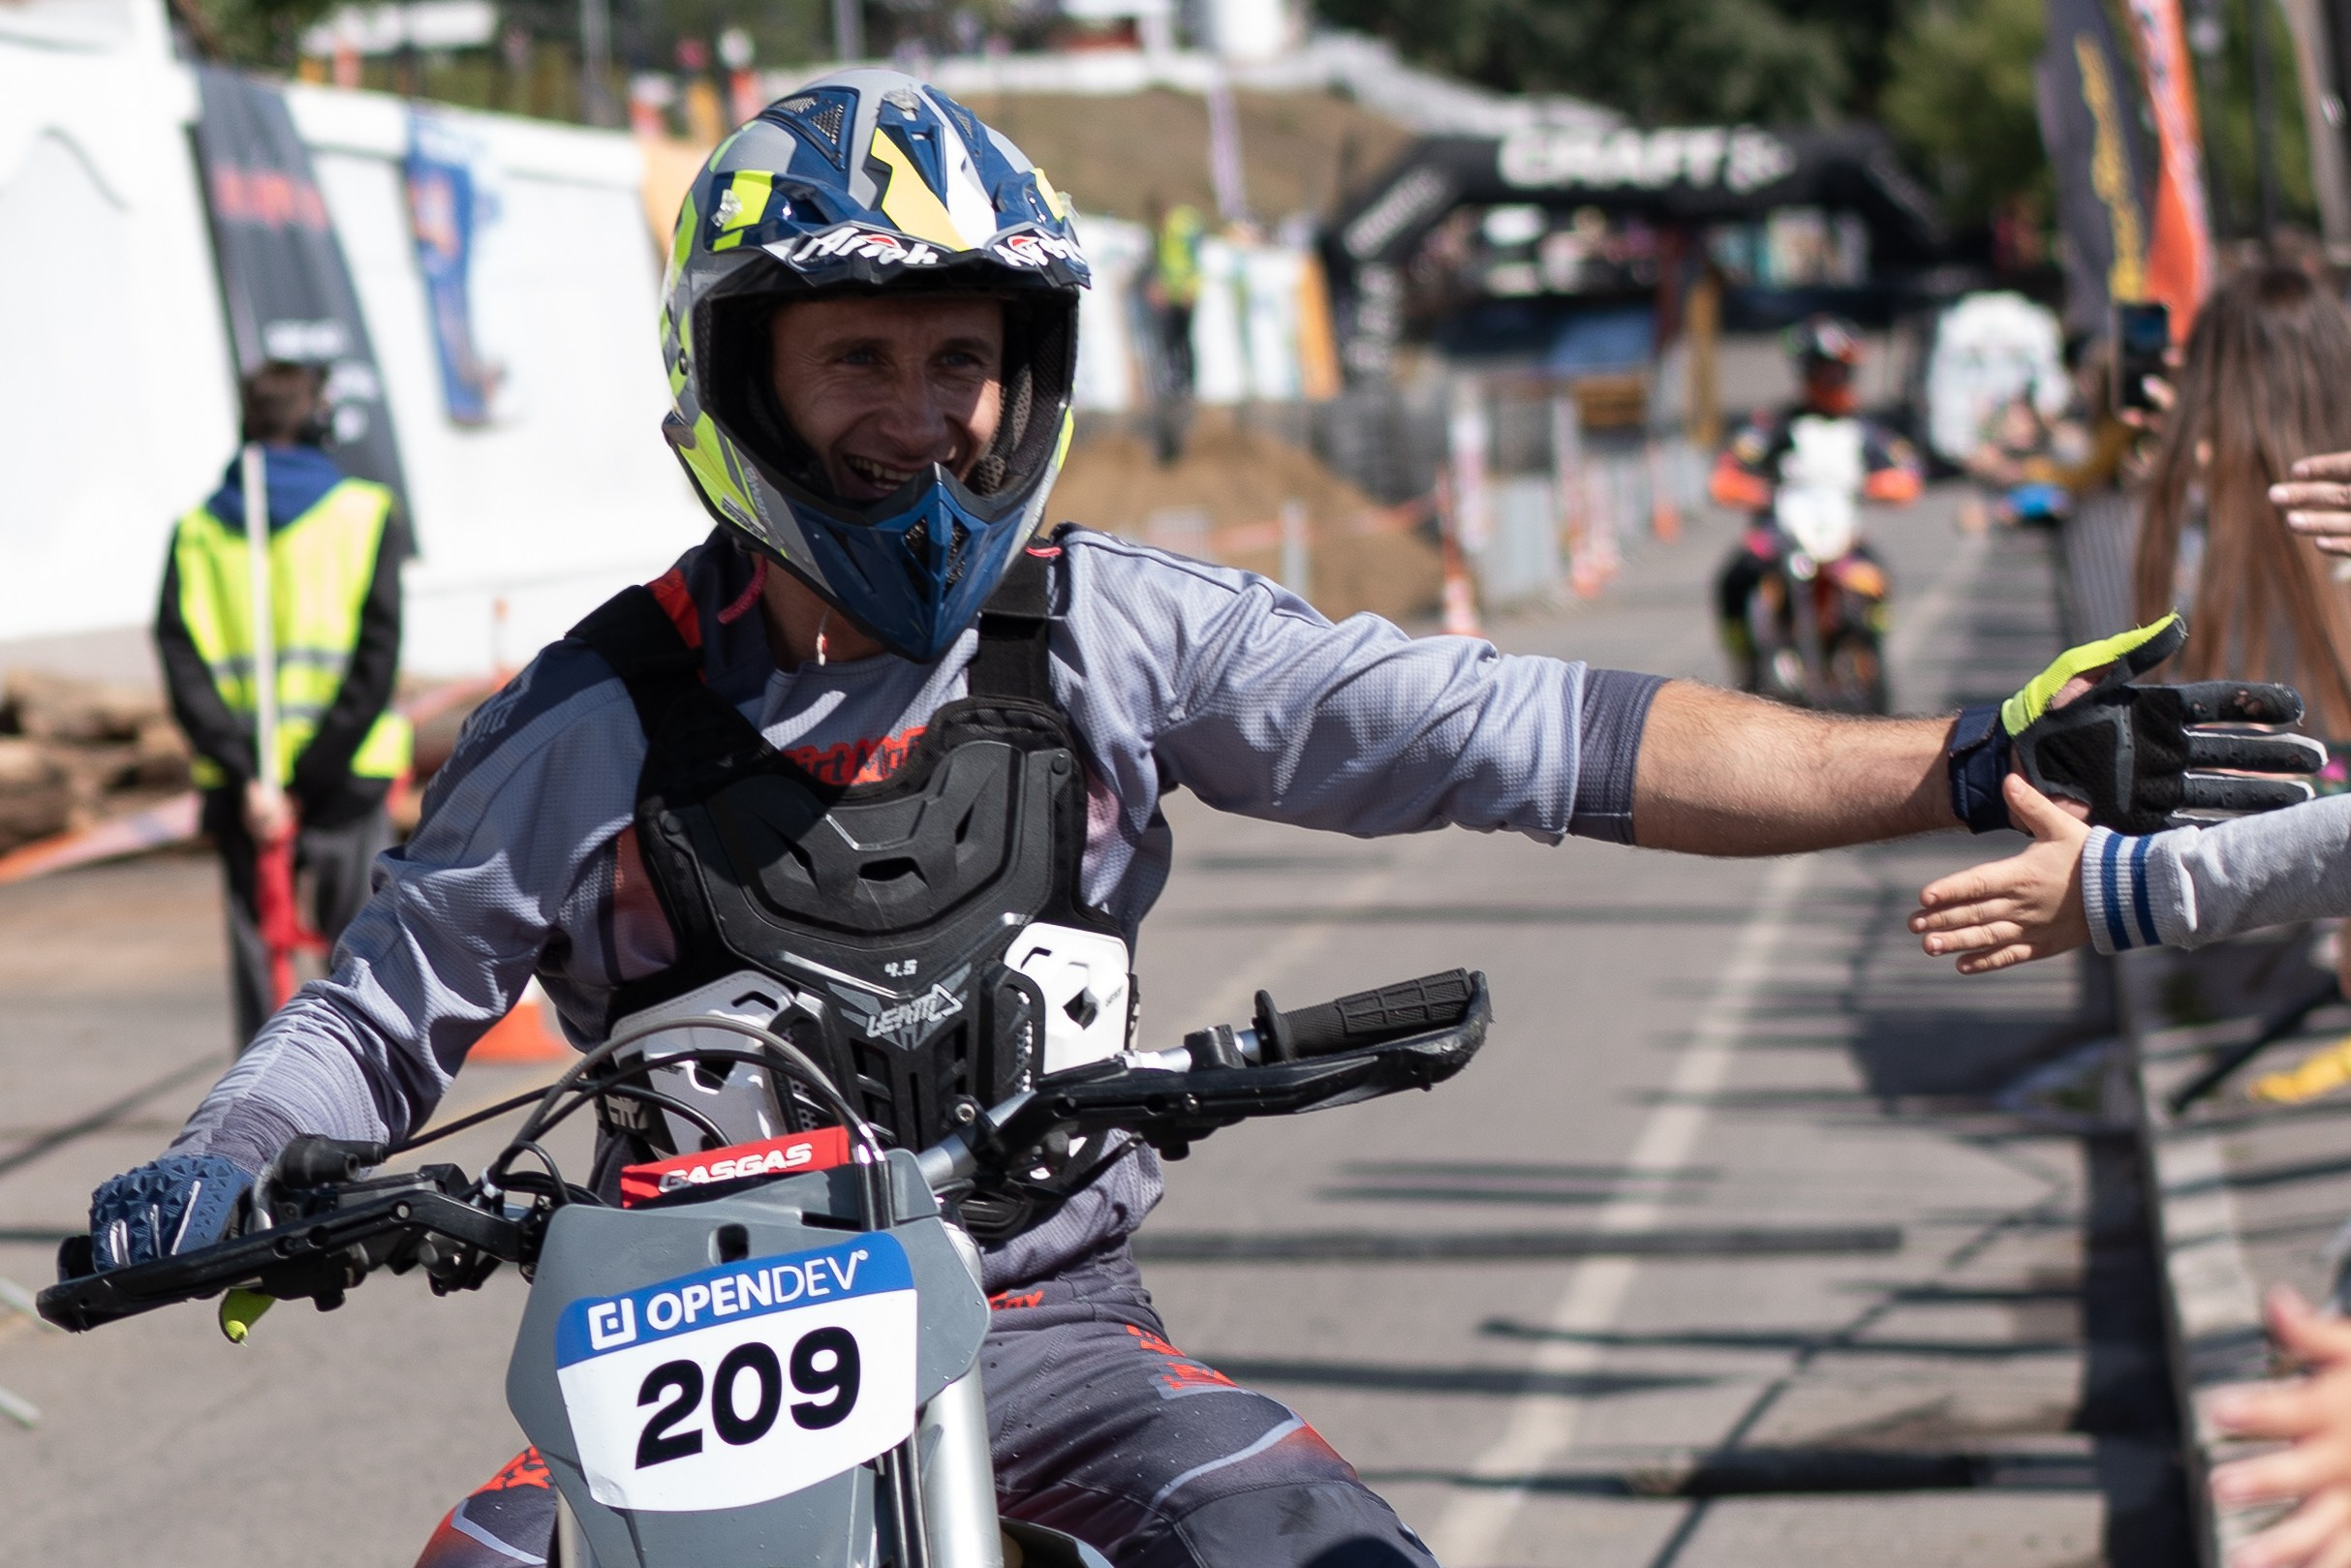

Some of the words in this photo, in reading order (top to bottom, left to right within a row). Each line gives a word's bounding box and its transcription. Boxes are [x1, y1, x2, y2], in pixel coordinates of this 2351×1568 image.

[883, 958, 918, 978] 4.5
[658, 1143, 813, 1193] GASGAS
[645, 1251, 859, 1332] OPENDEV
[634, 1325, 861, 1471] 209
